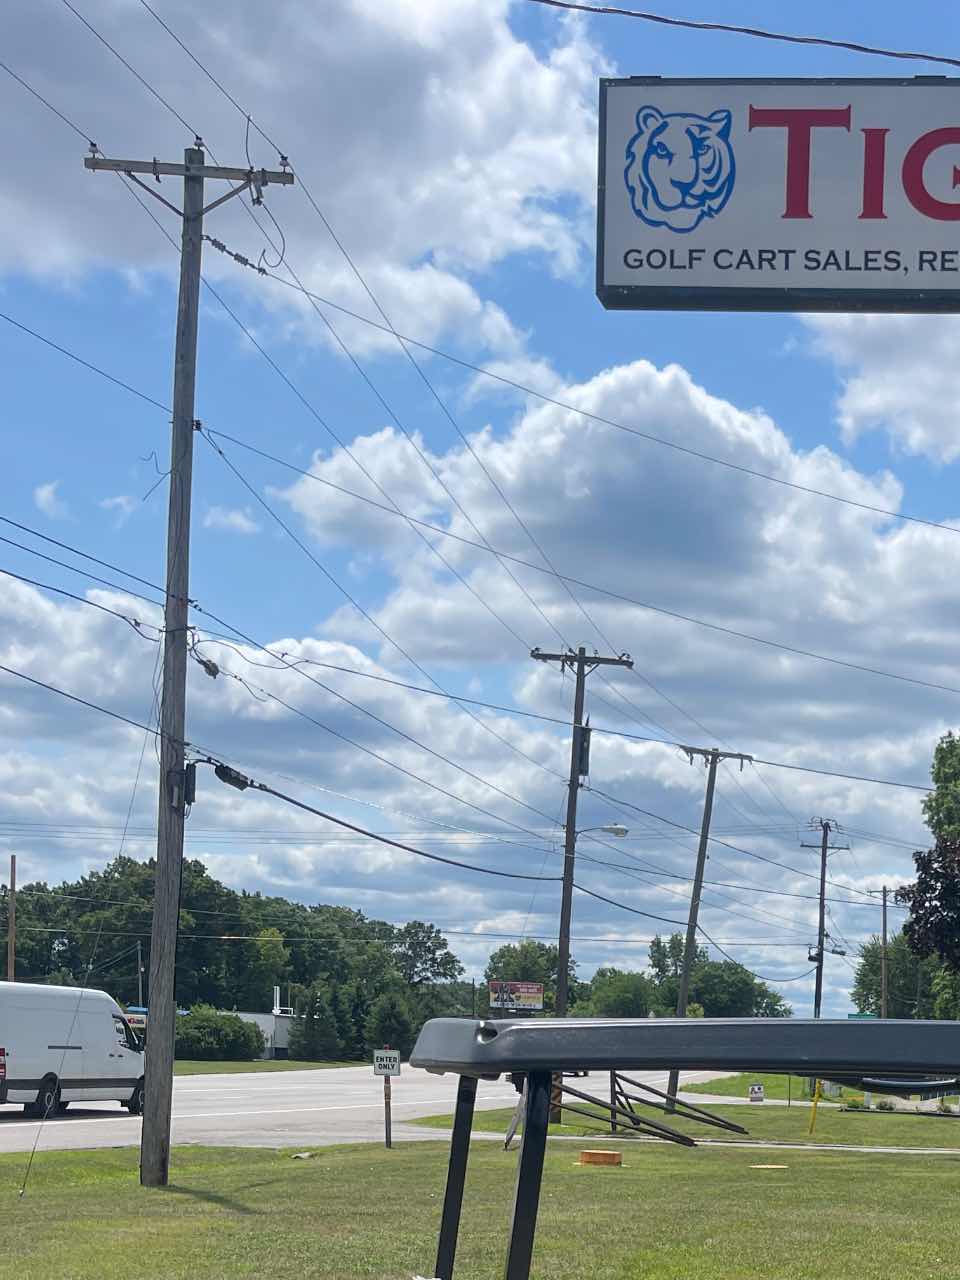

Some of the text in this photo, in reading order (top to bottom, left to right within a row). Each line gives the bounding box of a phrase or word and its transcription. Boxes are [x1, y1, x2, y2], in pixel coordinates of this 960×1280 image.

[623, 248, 706, 270] GOLF
[713, 249, 797, 271] CART
[803, 249, 909, 276] SALES,
